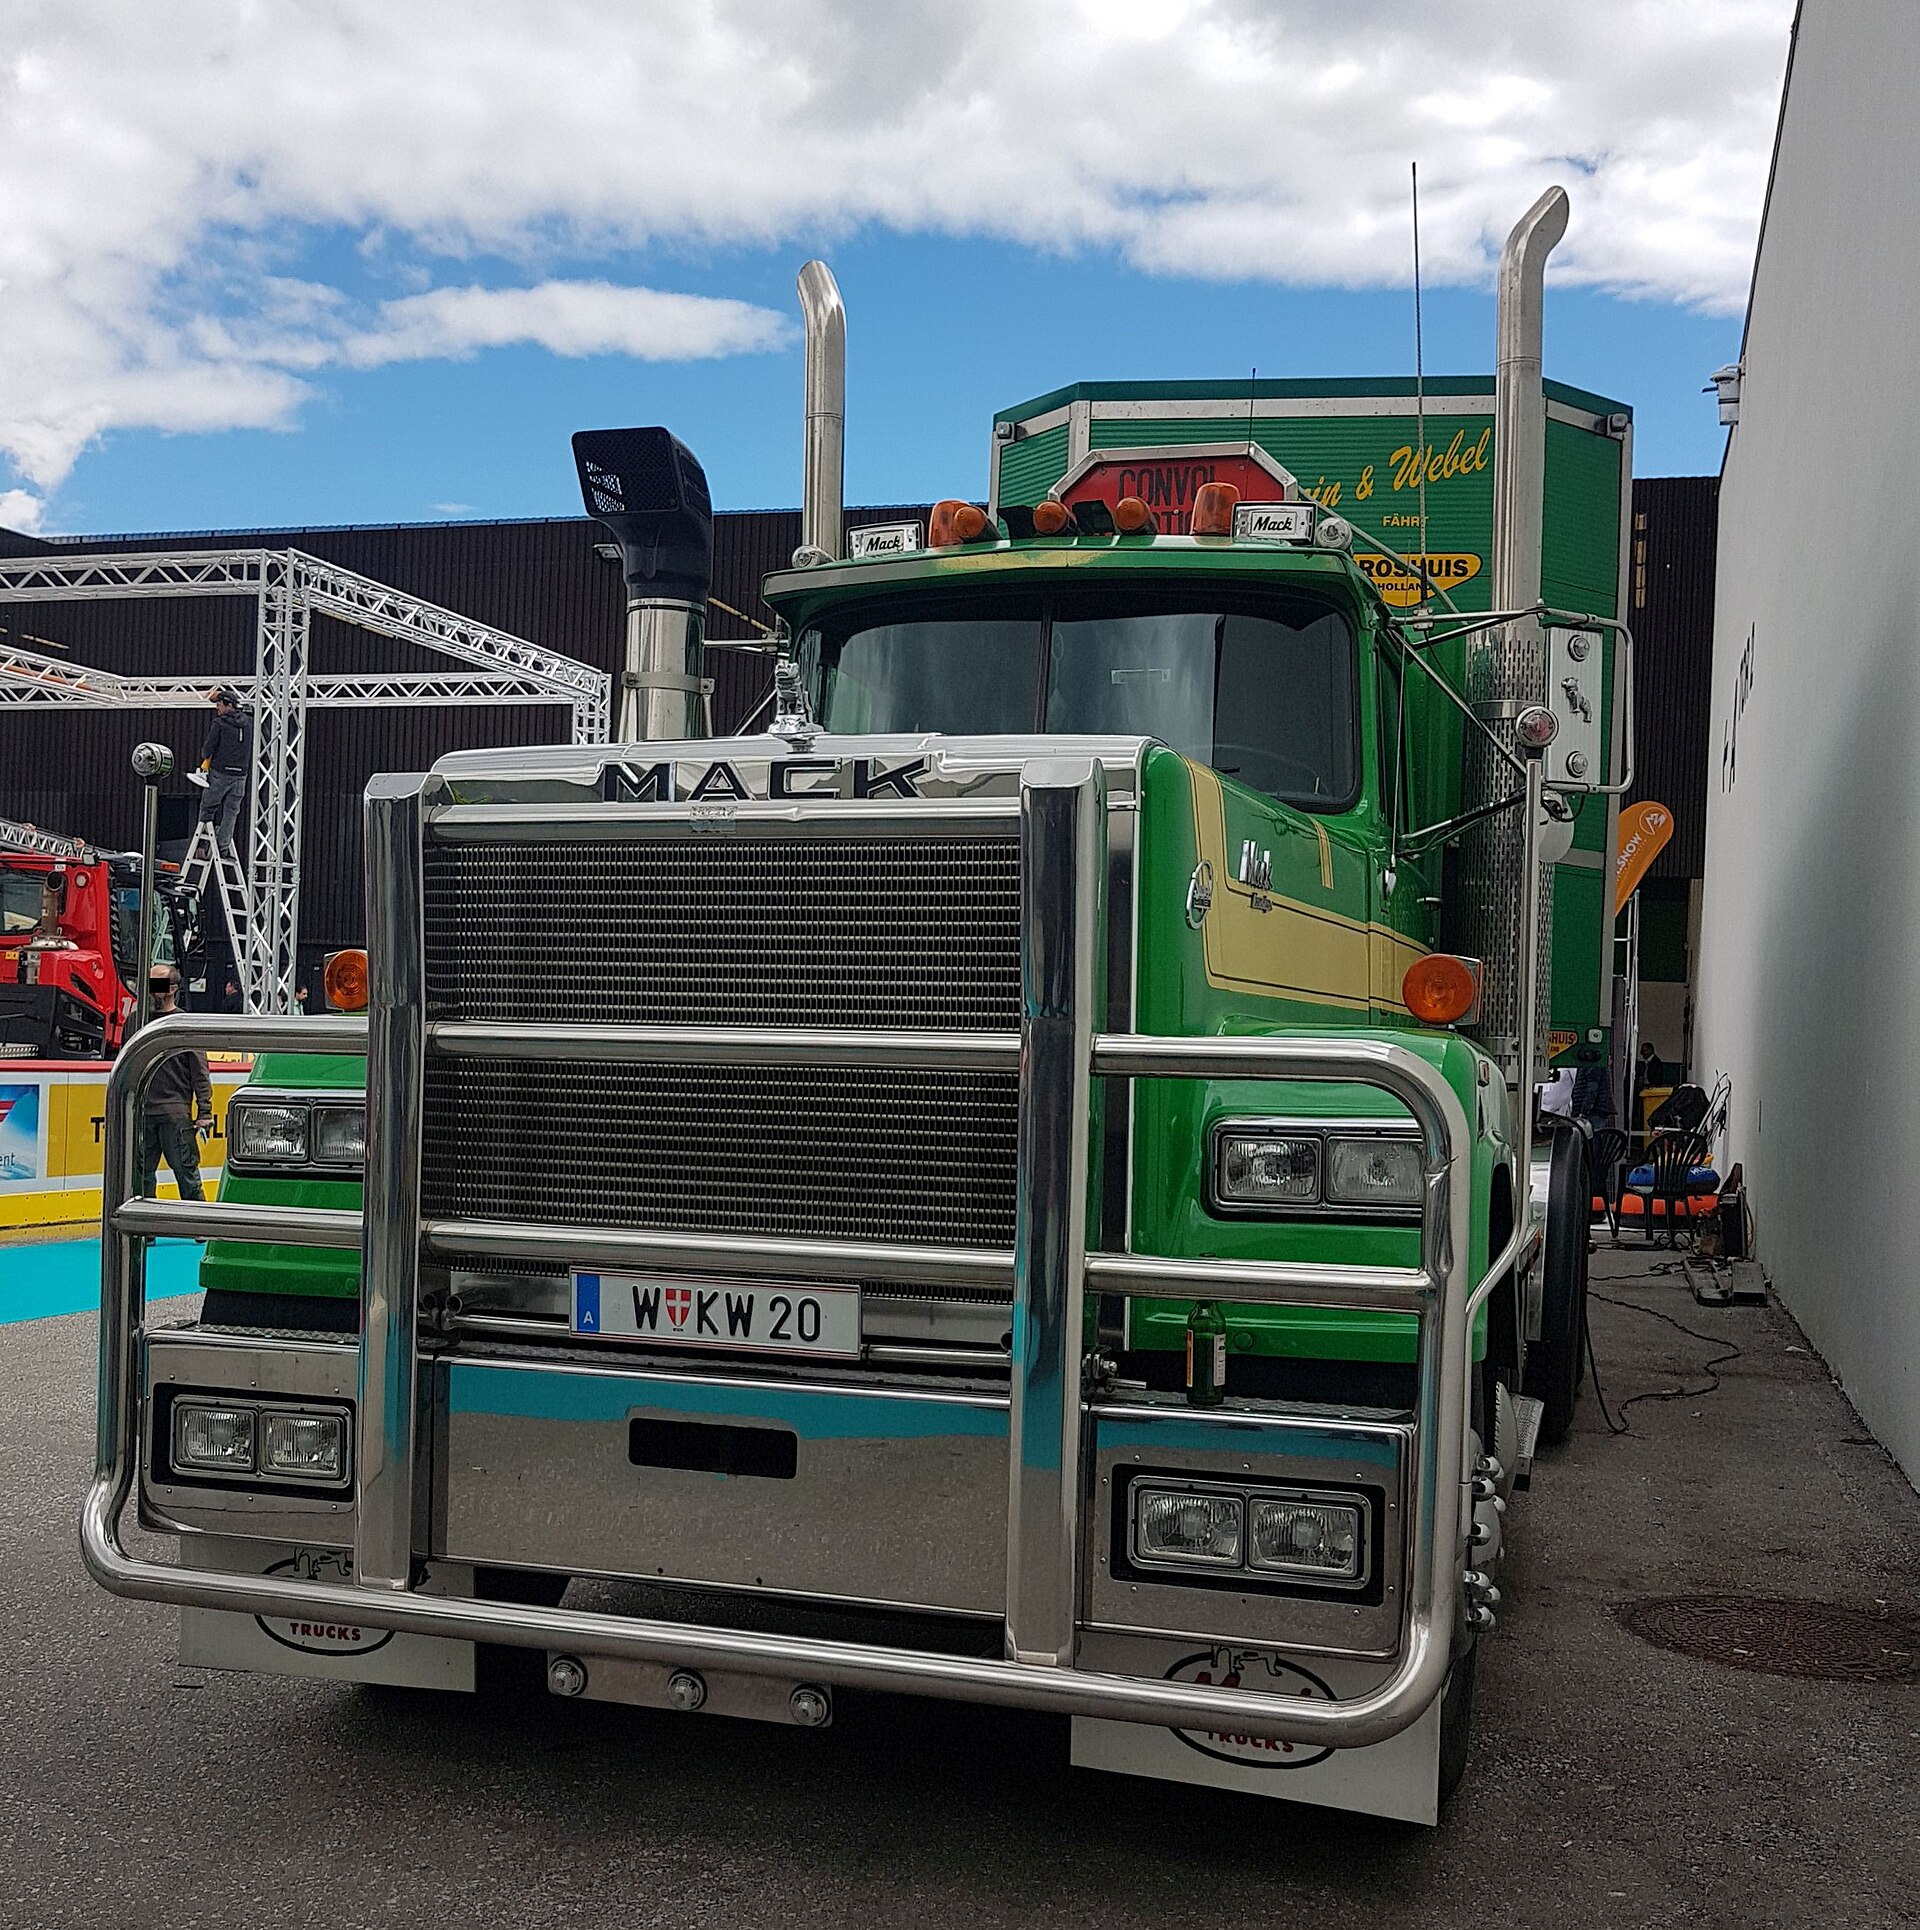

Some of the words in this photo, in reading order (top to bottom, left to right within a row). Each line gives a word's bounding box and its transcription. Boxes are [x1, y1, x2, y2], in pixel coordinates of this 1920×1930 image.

[1355, 465, 1374, 500] &
[1388, 427, 1491, 491] Webel
[1252, 515, 1293, 531] Mack
[865, 535, 902, 552] Mack
[602, 753, 934, 802] MACK
[582, 1310, 594, 1326] A
[631, 1284, 661, 1331] W
[696, 1289, 755, 1339] KW
[768, 1295, 822, 1343] 20
[289, 1622, 362, 1642] TRUCKS
